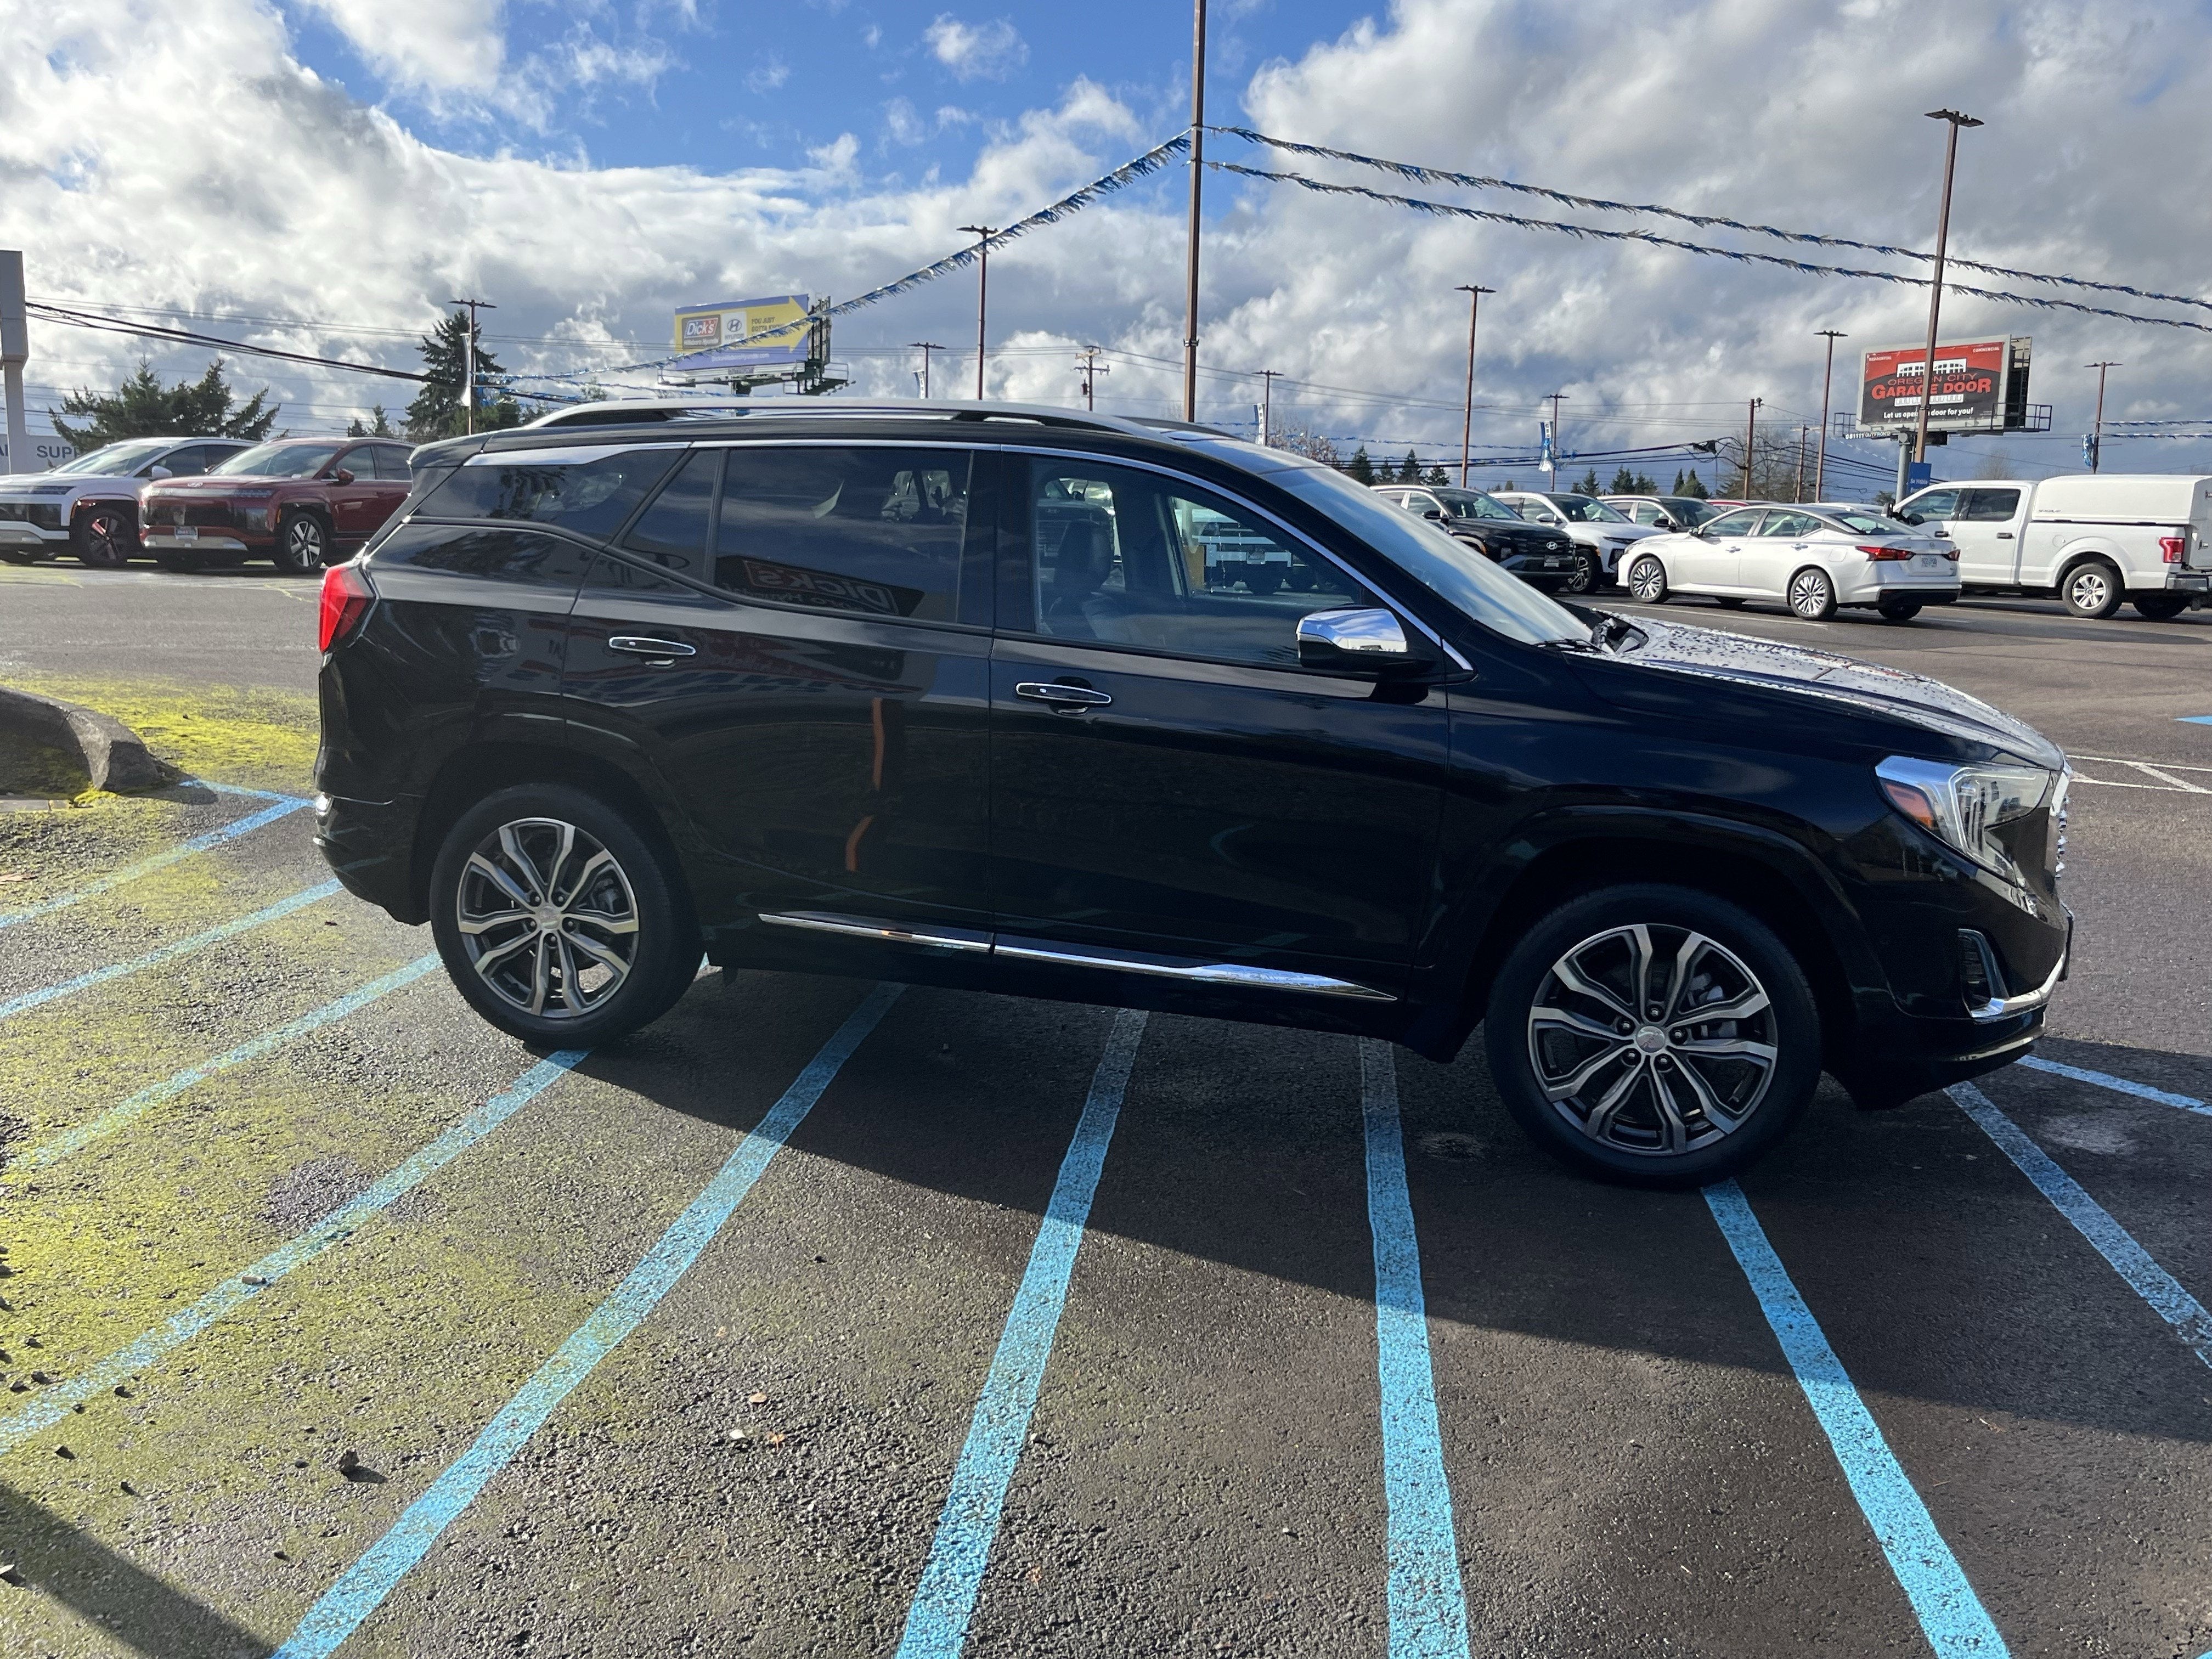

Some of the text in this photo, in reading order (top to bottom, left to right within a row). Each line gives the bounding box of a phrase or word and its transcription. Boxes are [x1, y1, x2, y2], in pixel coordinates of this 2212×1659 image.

[687, 320, 715, 336] Dick's
[1887, 373, 1977, 386] OREGN CITY
[1943, 377, 1992, 394] DOOR
[1957, 407, 1973, 416] you!
